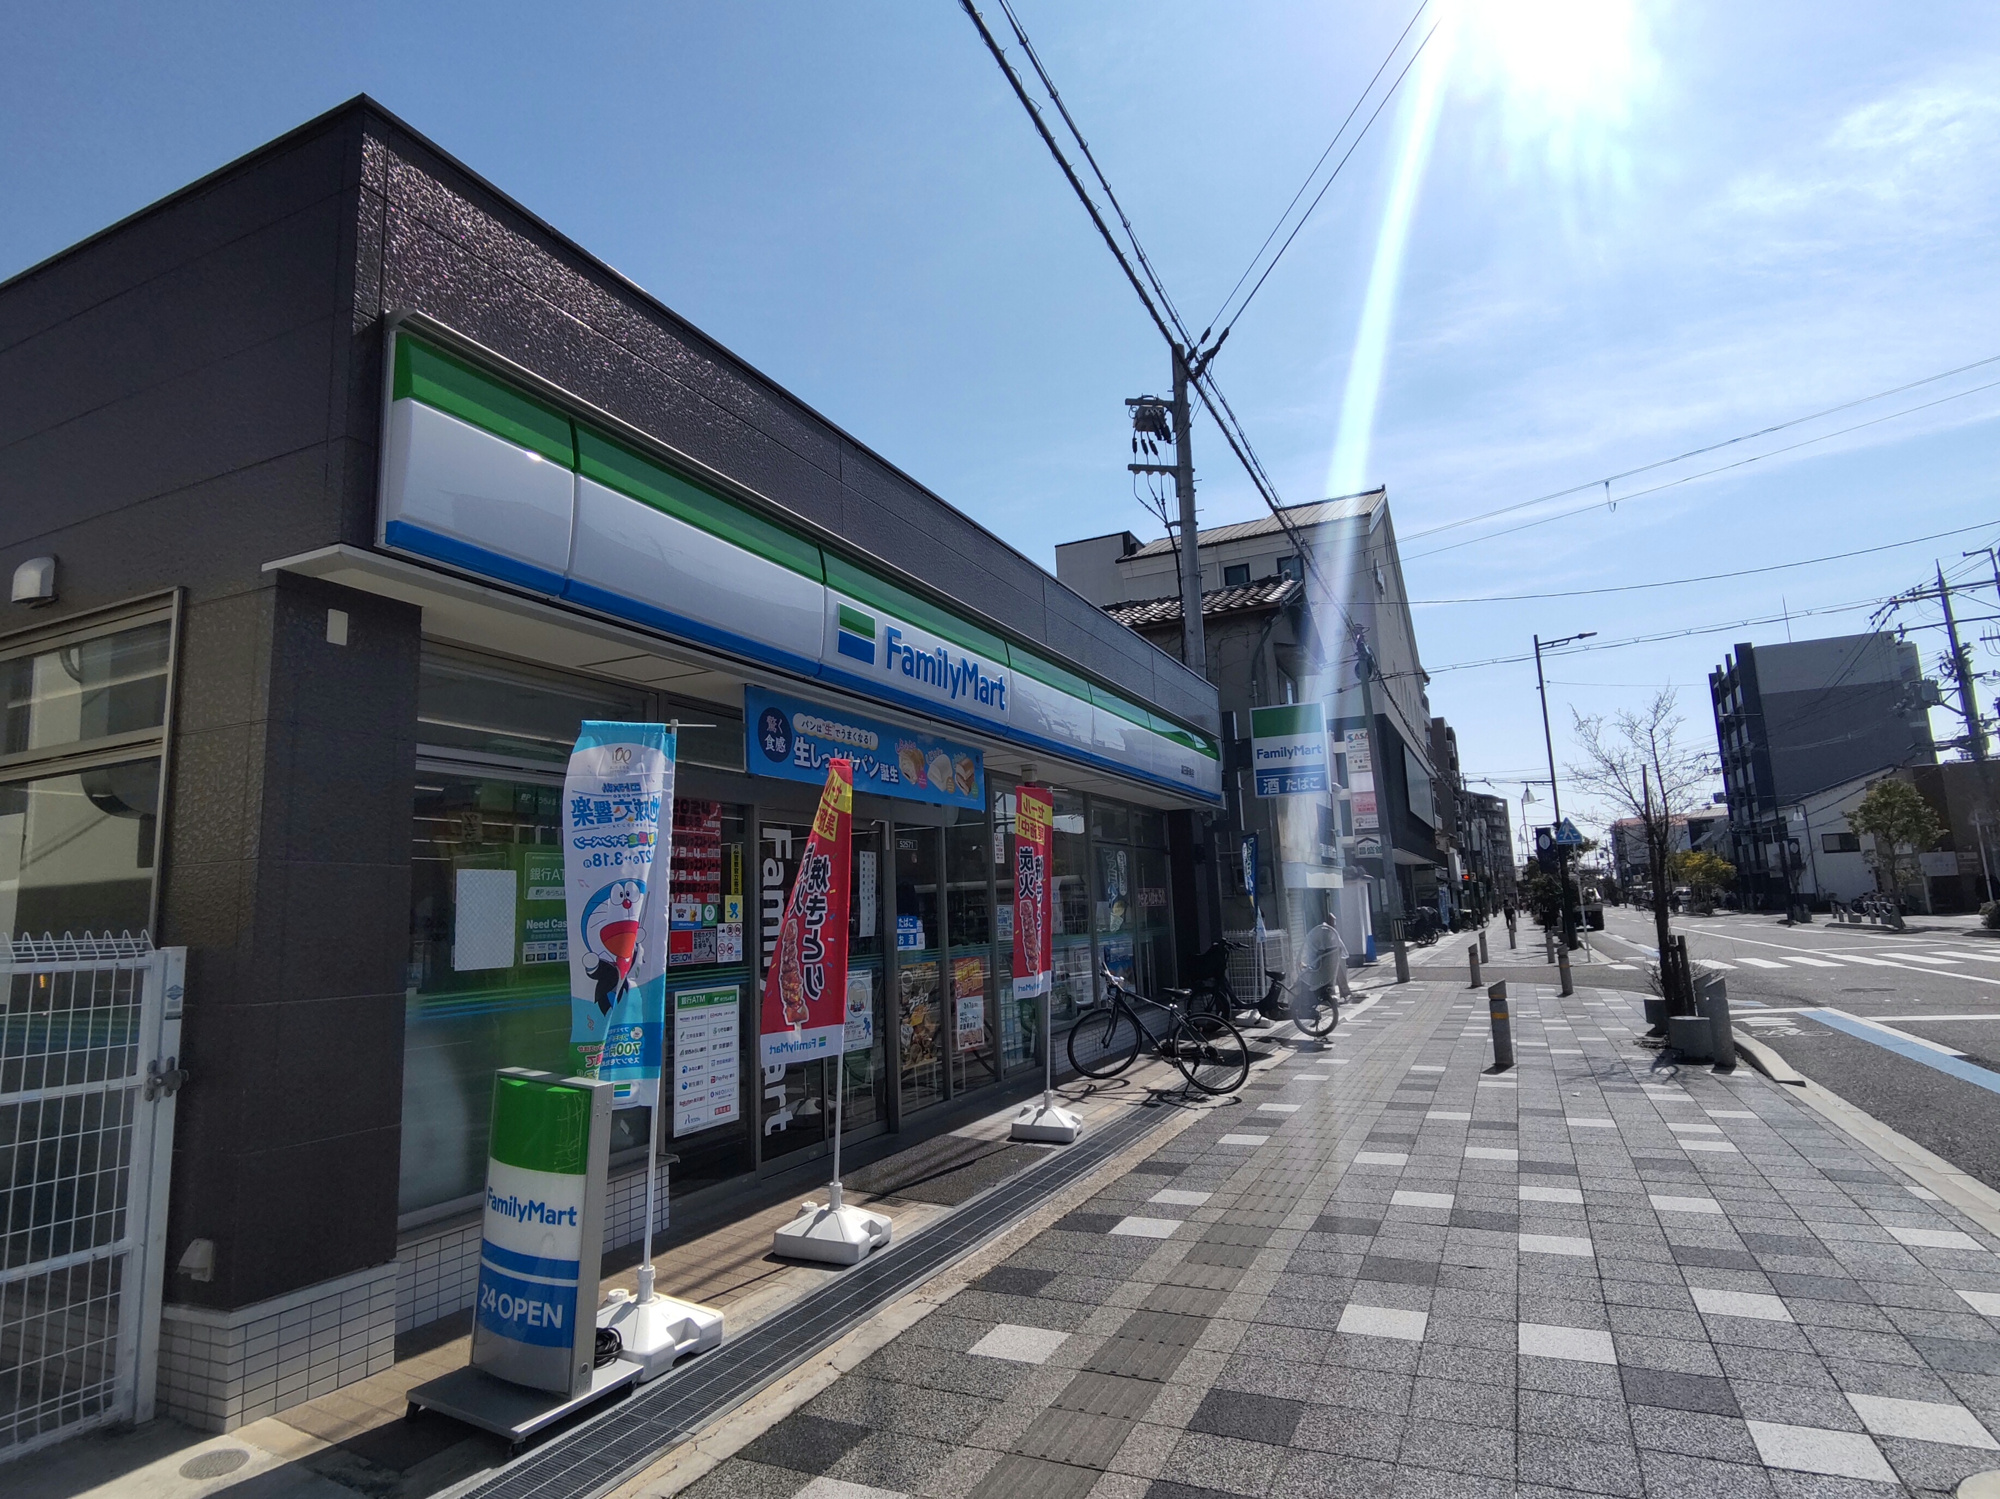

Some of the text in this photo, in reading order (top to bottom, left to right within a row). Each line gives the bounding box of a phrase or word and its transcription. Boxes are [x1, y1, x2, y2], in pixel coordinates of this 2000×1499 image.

[887, 624, 1006, 711] FamilyMart
[766, 715, 783, 734] 驚く
[764, 734, 787, 753] 食感
[1256, 744, 1322, 759] FamilyMart
[1263, 776, 1321, 794] 酒 たばこ
[529, 867, 565, 881] 銀行AT
[526, 918, 567, 930] Need Cas
[671, 954, 692, 962] SECOM
[486, 1186, 578, 1227] FamilyMart
[481, 1283, 563, 1329] 24 OPEN
